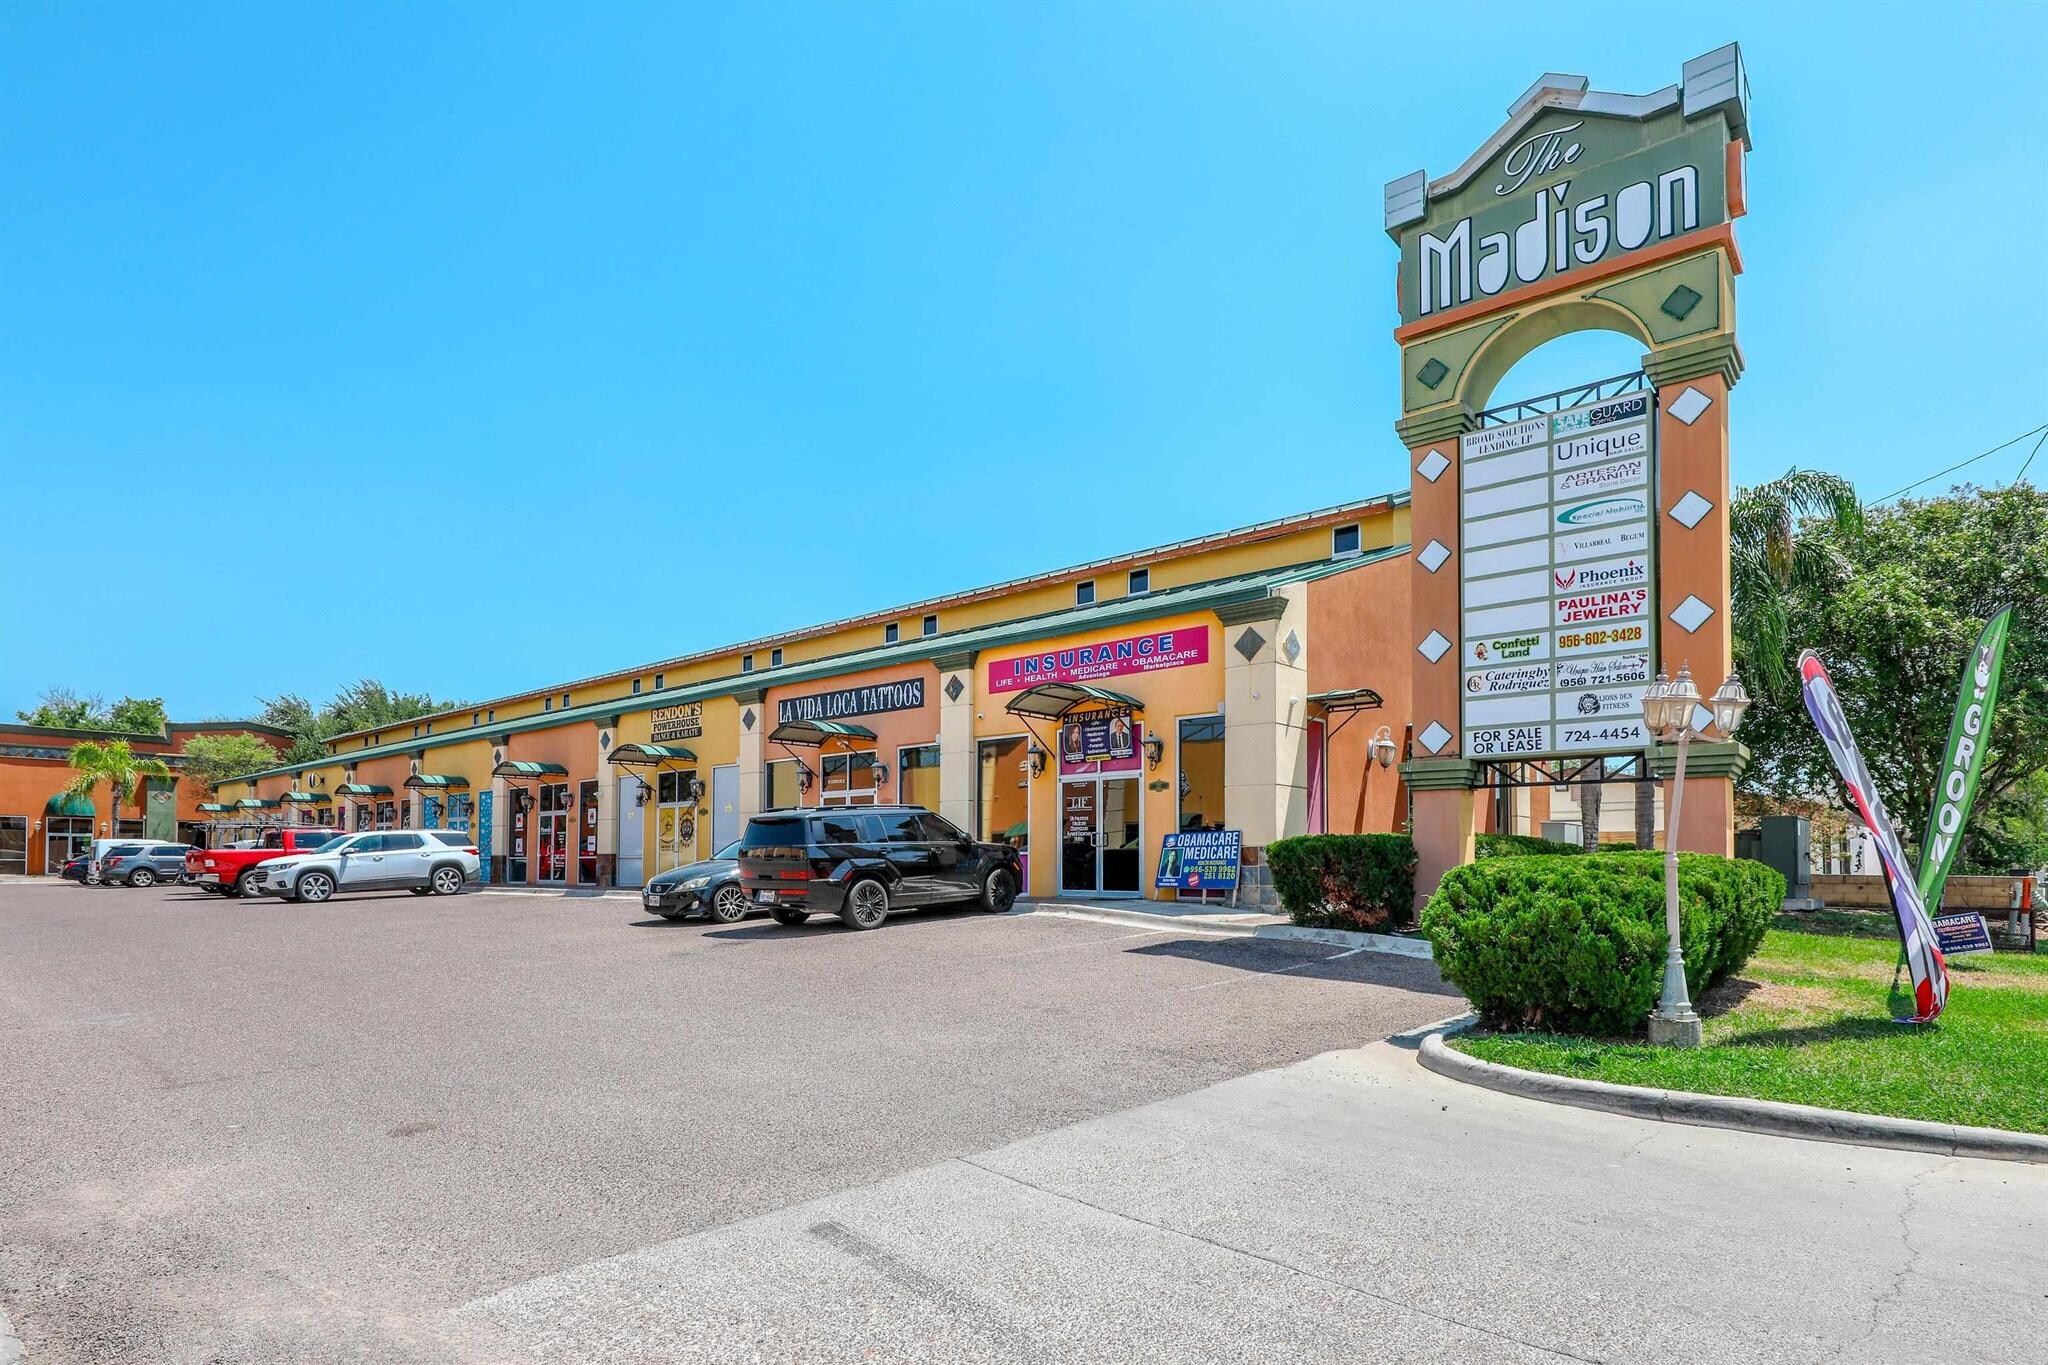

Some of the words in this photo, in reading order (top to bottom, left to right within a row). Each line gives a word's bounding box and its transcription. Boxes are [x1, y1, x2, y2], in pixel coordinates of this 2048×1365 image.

[1495, 121, 1584, 195] The
[1419, 165, 1699, 316] Madison
[1590, 399, 1643, 420] GUARD
[1466, 433, 1494, 447] BROAD
[1498, 421, 1545, 438] SOLUTIONS
[1521, 434, 1533, 445] LP
[1558, 432, 1640, 460] Unique
[1624, 445, 1644, 453] SALON
[1565, 461, 1641, 482] ARTESAN
[1575, 467, 1641, 487] GRANITE
[1574, 538, 1612, 549] VILLARREAL
[1620, 532, 1645, 542] BEGUM
[1579, 560, 1644, 583] Phoenix
[1580, 579, 1618, 588] INSURANCE
[1621, 575, 1644, 583] GROUP
[1558, 589, 1647, 611] PAULINA'S
[1562, 603, 1641, 623] JEWELRY
[1492, 636, 1540, 650] Confetti
[1559, 626, 1642, 648] 956-602-3428
[1014, 634, 1174, 676] INSURANCE
[1502, 647, 1530, 659] Land
[995, 677, 1013, 687] LIFE
[1024, 671, 1058, 683] HEALTH
[1070, 661, 1118, 676] MEDICARE
[1132, 649, 1198, 667] OBAMACARE
[1143, 660, 1185, 671] Marketplace
[1078, 671, 1110, 681] Advantage
[1560, 677, 1586, 688] (956)
[1590, 671, 1645, 684] 721-5606
[1489, 678, 1550, 692] Rodriguez
[779, 703, 792, 723] LA
[795, 697, 824, 720] VIDA
[826, 692, 859, 716] LOCA
[861, 681, 921, 711] TATTOOS
[1599, 693, 1618, 701] LIONS
[1619, 692, 1633, 700] DEN
[652, 702, 702, 722] RENDON'S
[1602, 702, 1630, 710] FITNESS
[1068, 707, 1125, 723] INSURANCE
[653, 717, 700, 732] POWERHOUSE
[1473, 731, 1501, 743] FOR
[1508, 728, 1542, 739] SALE
[1564, 726, 1640, 743] 724-4454
[1473, 742, 1494, 754] OR
[1500, 739, 1542, 753] LEASE
[1177, 832, 1239, 847] OBAMACARE
[1185, 846, 1237, 860] MEDICARE
[1932, 915, 1977, 929] BAMACARE
